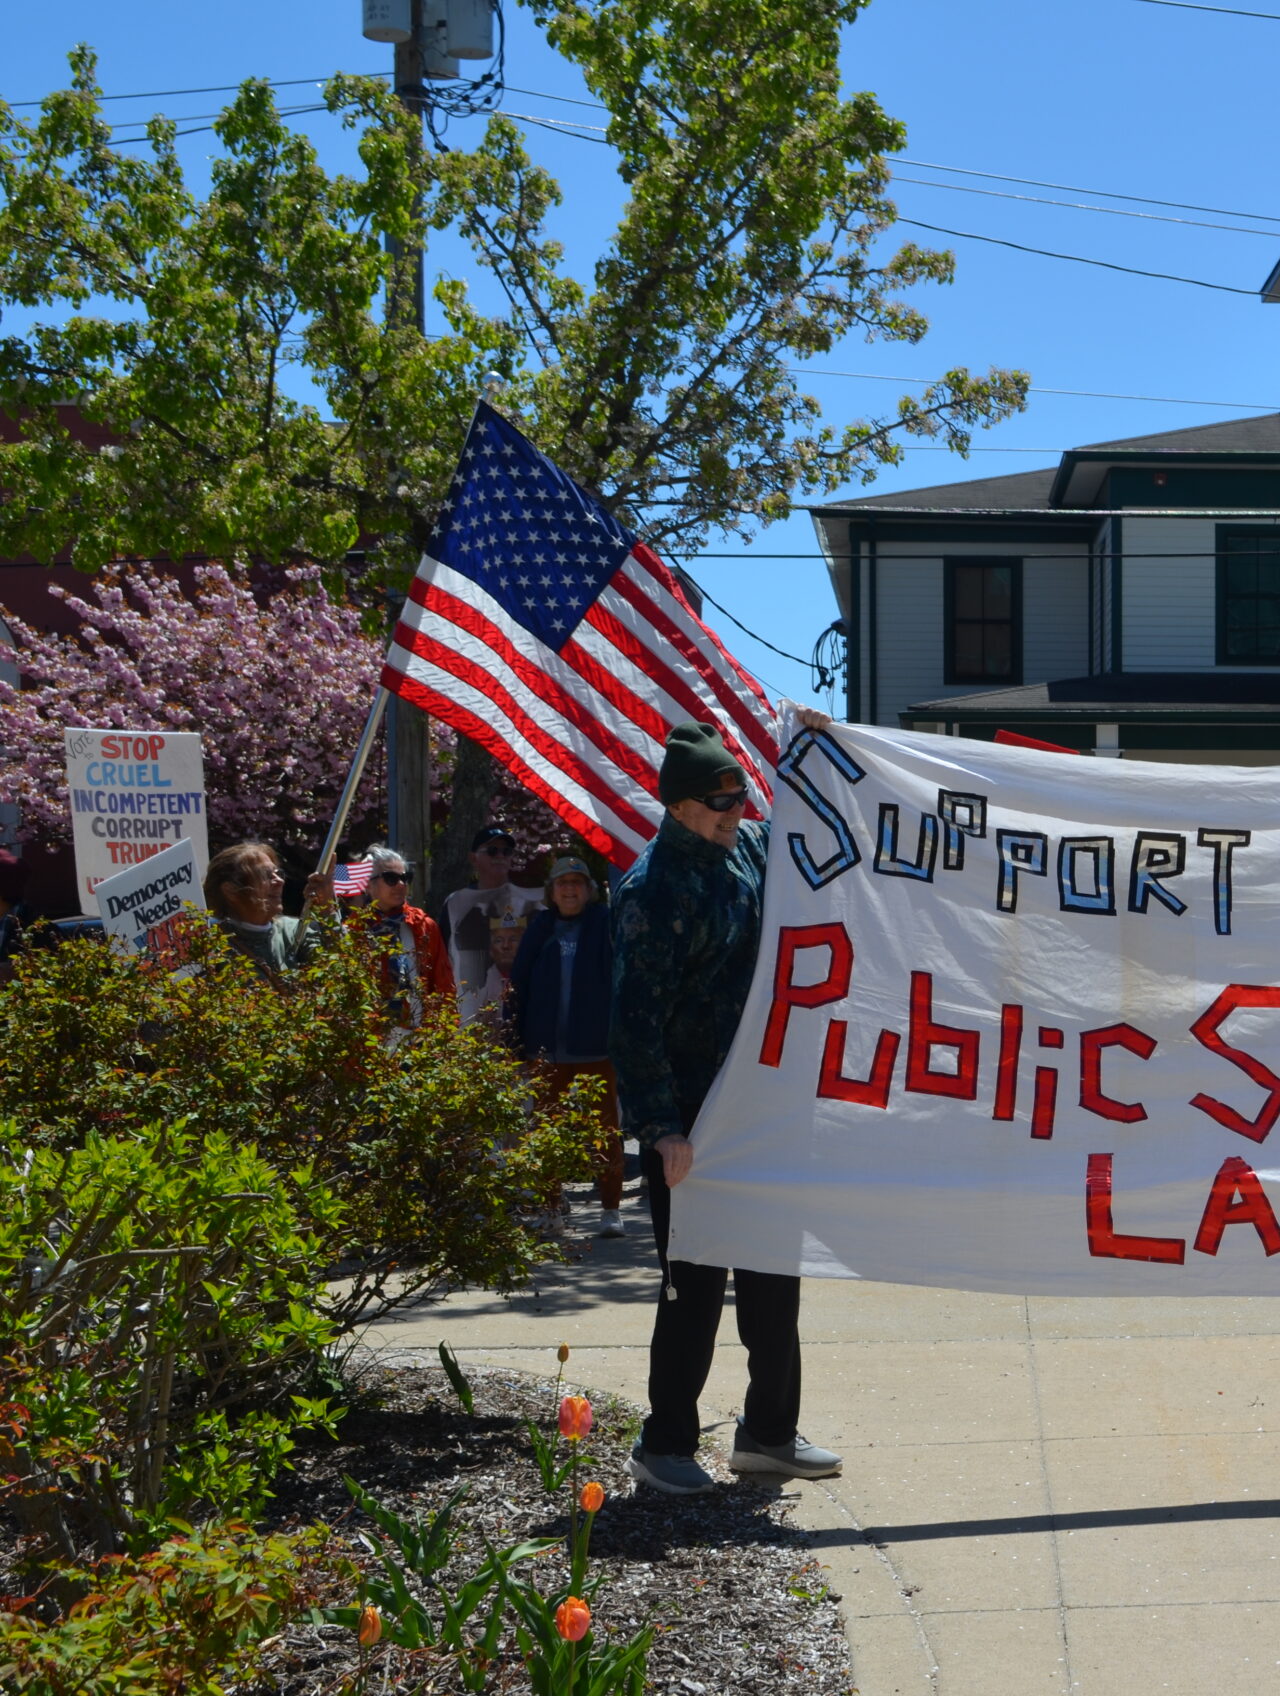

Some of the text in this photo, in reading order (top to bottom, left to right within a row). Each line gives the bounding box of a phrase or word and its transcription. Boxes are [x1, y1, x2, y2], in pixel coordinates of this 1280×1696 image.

[101, 735, 165, 761] STOP
[86, 761, 172, 787] CRUEL
[73, 789, 202, 815] INCOMPETENT
[91, 816, 183, 839] CORRUPT
[777, 729, 1250, 935] SUPPORT
[106, 862, 192, 919] Democracy
[133, 892, 181, 931] Needs
[758, 922, 1158, 1140] Public
